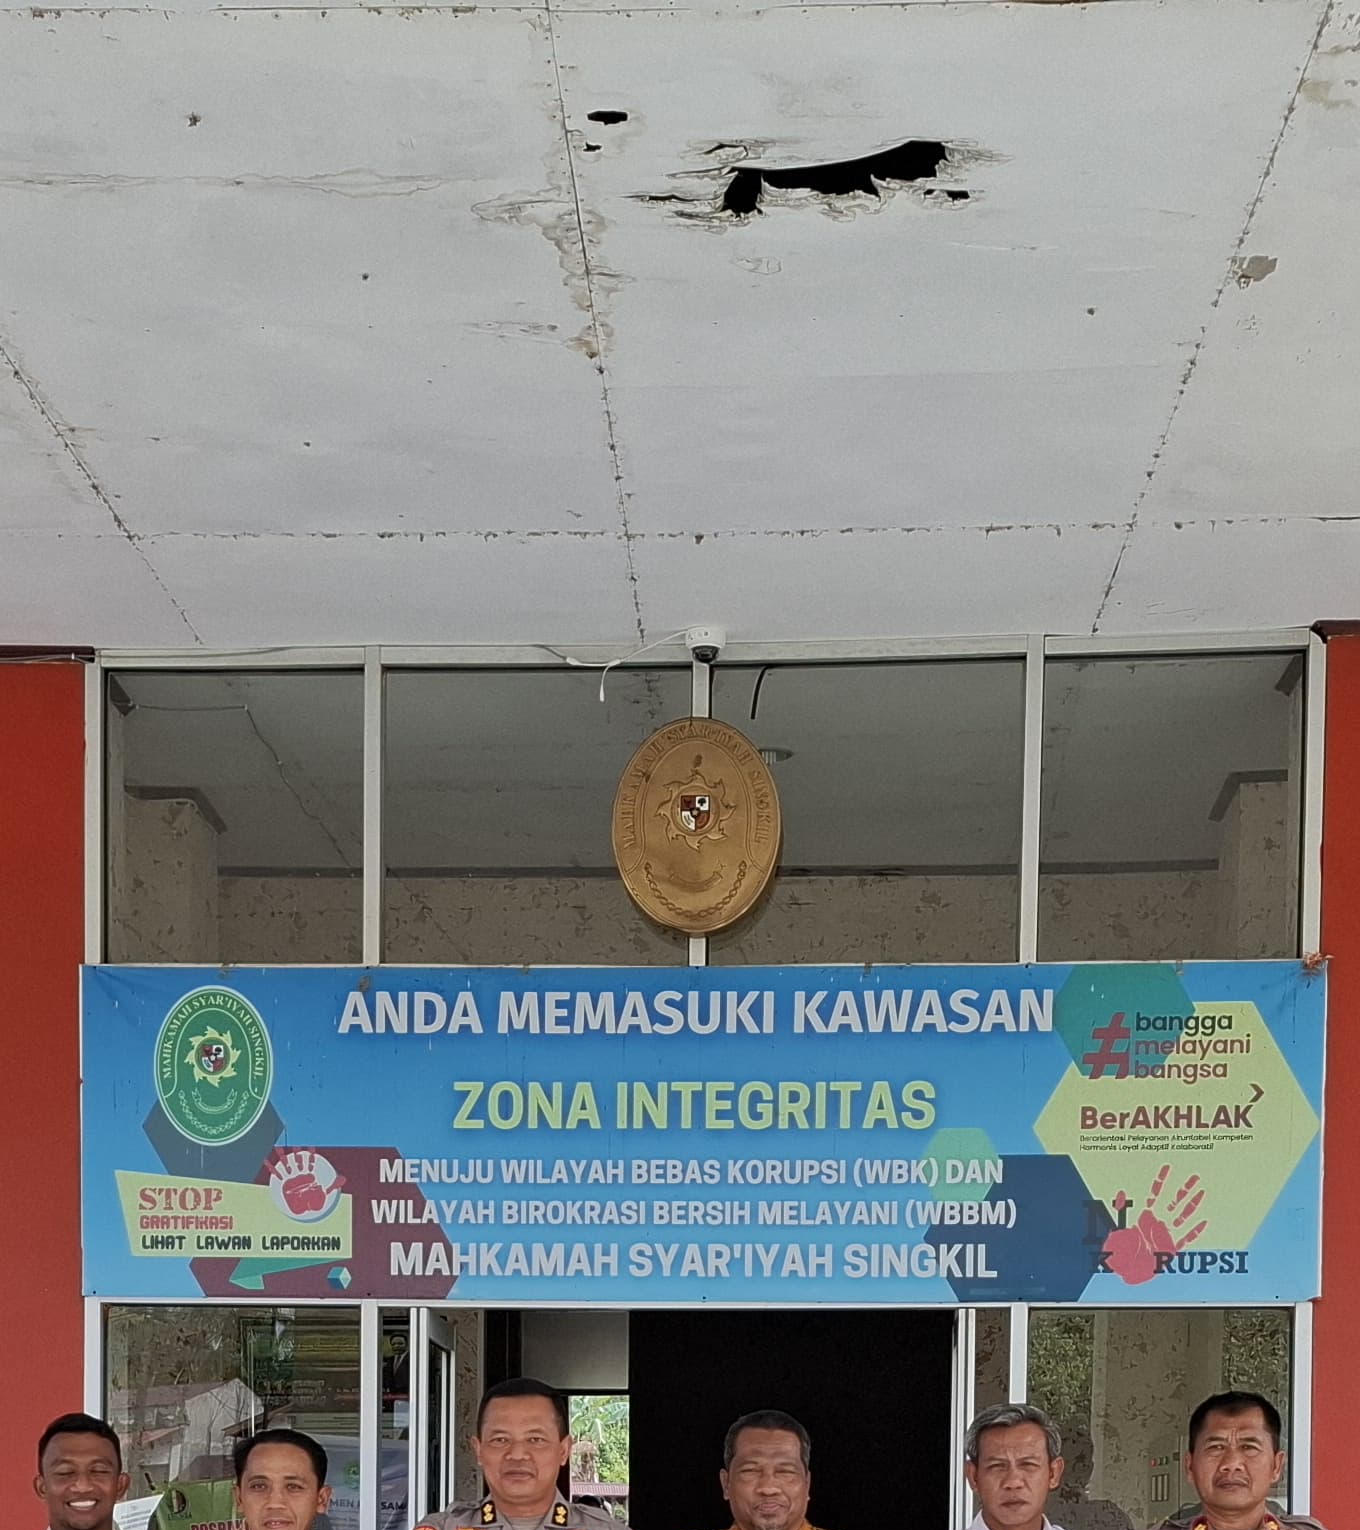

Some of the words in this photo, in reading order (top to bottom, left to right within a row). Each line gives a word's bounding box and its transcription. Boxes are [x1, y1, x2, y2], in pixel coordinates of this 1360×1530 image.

[338, 990, 484, 1035] ANDA
[497, 989, 775, 1035] MEMASUKI
[793, 988, 1054, 1034] KAWASAN
[1135, 1011, 1233, 1037] bangga
[161, 1004, 192, 1079] MAHKAMAH
[248, 1025, 265, 1079] SINGKIL
[1134, 1033, 1251, 1061] melayani
[1134, 1060, 1228, 1085] bangsa
[452, 1081, 602, 1130] ZONA
[617, 1079, 937, 1130] INTEGRITAS
[1080, 1103, 1254, 1130] BerAKHLAK
[1119, 1143, 1139, 1152] Loyal
[379, 1159, 494, 1185] MENUJU
[501, 1159, 625, 1185] WILAYAH
[631, 1159, 721, 1185] BEBAS
[727, 1159, 847, 1185] KORUPSI
[853, 1158, 939, 1188] (WBK)
[944, 1159, 1004, 1184] DAN
[138, 1187, 223, 1211] STOP
[139, 1214, 234, 1230] GRATIFIKASI
[371, 1199, 496, 1225] WILAYAH
[503, 1199, 645, 1225] BIROKRASI
[652, 1199, 754, 1225] BERSIH
[758, 1199, 899, 1226] MELAYANI
[904, 1198, 1017, 1228] (WBBM)
[141, 1234, 186, 1250] LIHAT
[196, 1235, 252, 1250] LAWAN
[261, 1235, 342, 1251] LAPORKAN
[389, 1242, 619, 1277] MAHKAMAH
[628, 1242, 834, 1278] SYAR'IYAH
[842, 1242, 998, 1279] SINGKIL
[1090, 1251, 1249, 1274] KRUPSI
